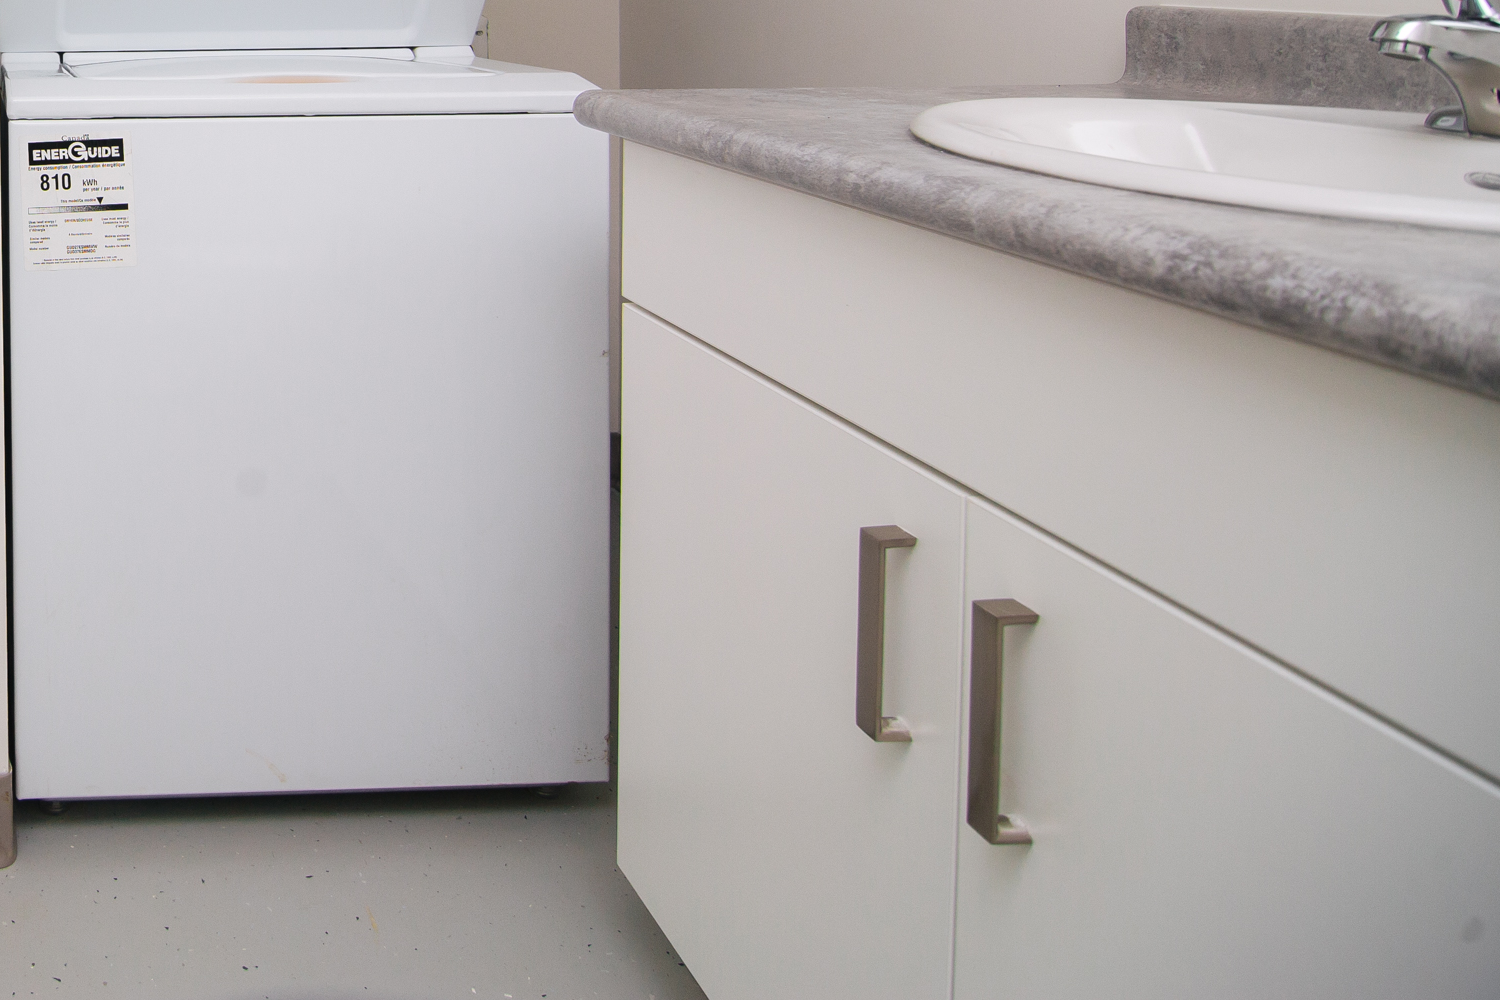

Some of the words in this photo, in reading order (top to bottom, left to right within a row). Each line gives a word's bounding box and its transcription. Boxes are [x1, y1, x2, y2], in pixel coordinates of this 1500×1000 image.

[32, 142, 120, 162] ENERGUIDE
[40, 172, 72, 192] 810
[82, 179, 98, 187] kWh
